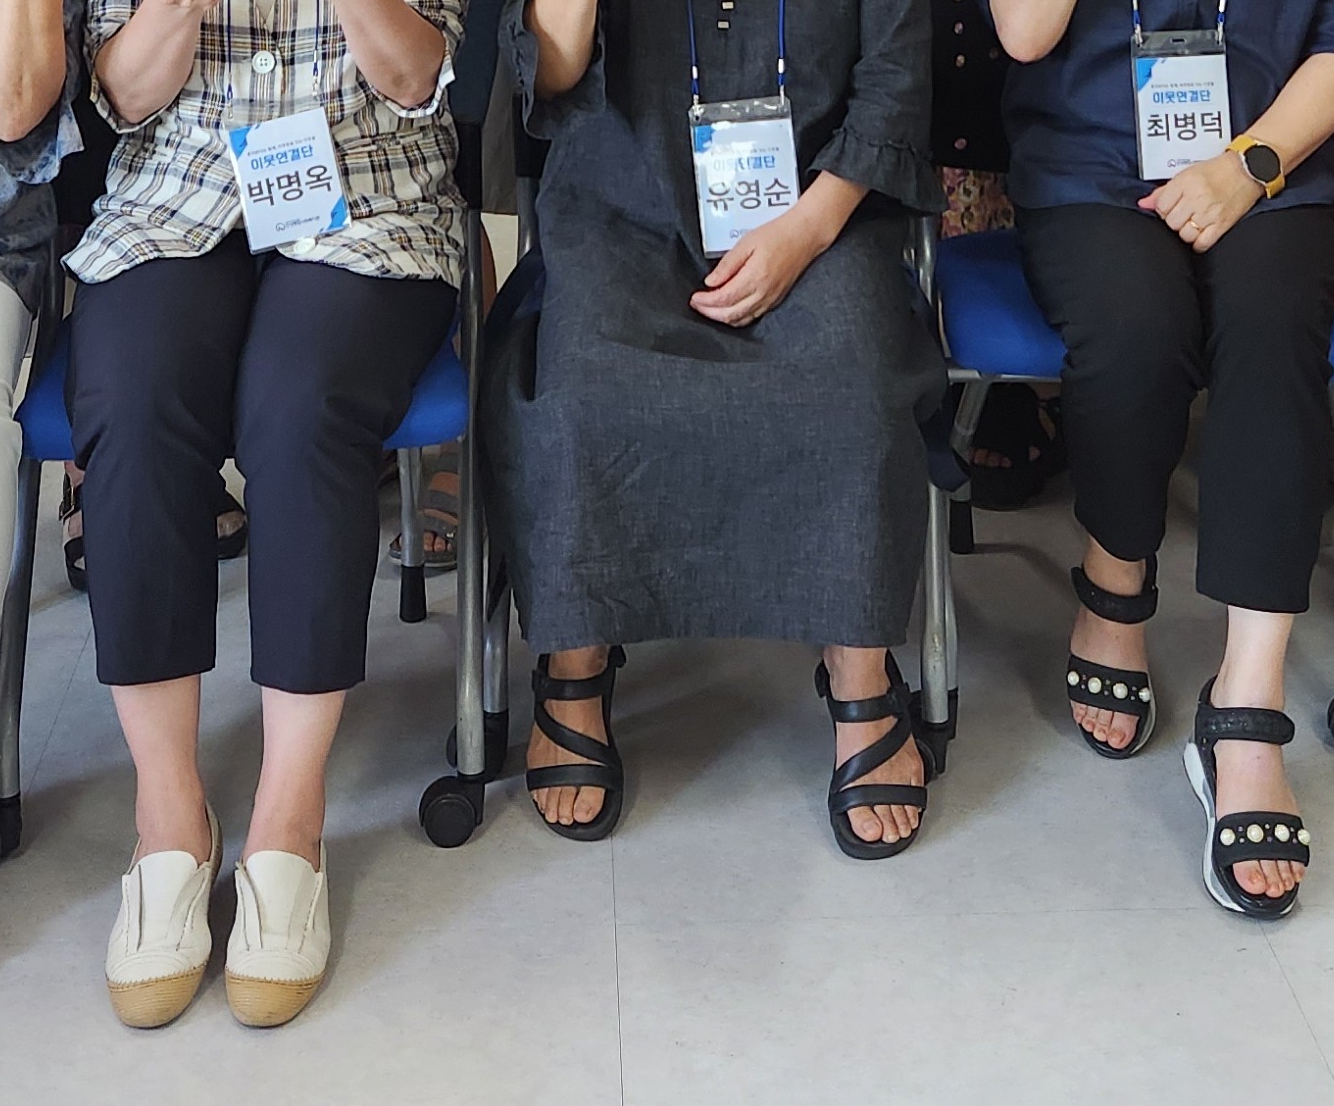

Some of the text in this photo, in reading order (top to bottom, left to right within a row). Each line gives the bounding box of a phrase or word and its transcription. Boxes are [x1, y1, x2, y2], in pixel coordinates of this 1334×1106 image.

[1153, 90, 1211, 104] 이웃연결단
[1147, 111, 1223, 141] 최병덕
[250, 145, 314, 171] 이웃연결단
[247, 165, 333, 206] 박명옥
[706, 178, 792, 212] 유영순
